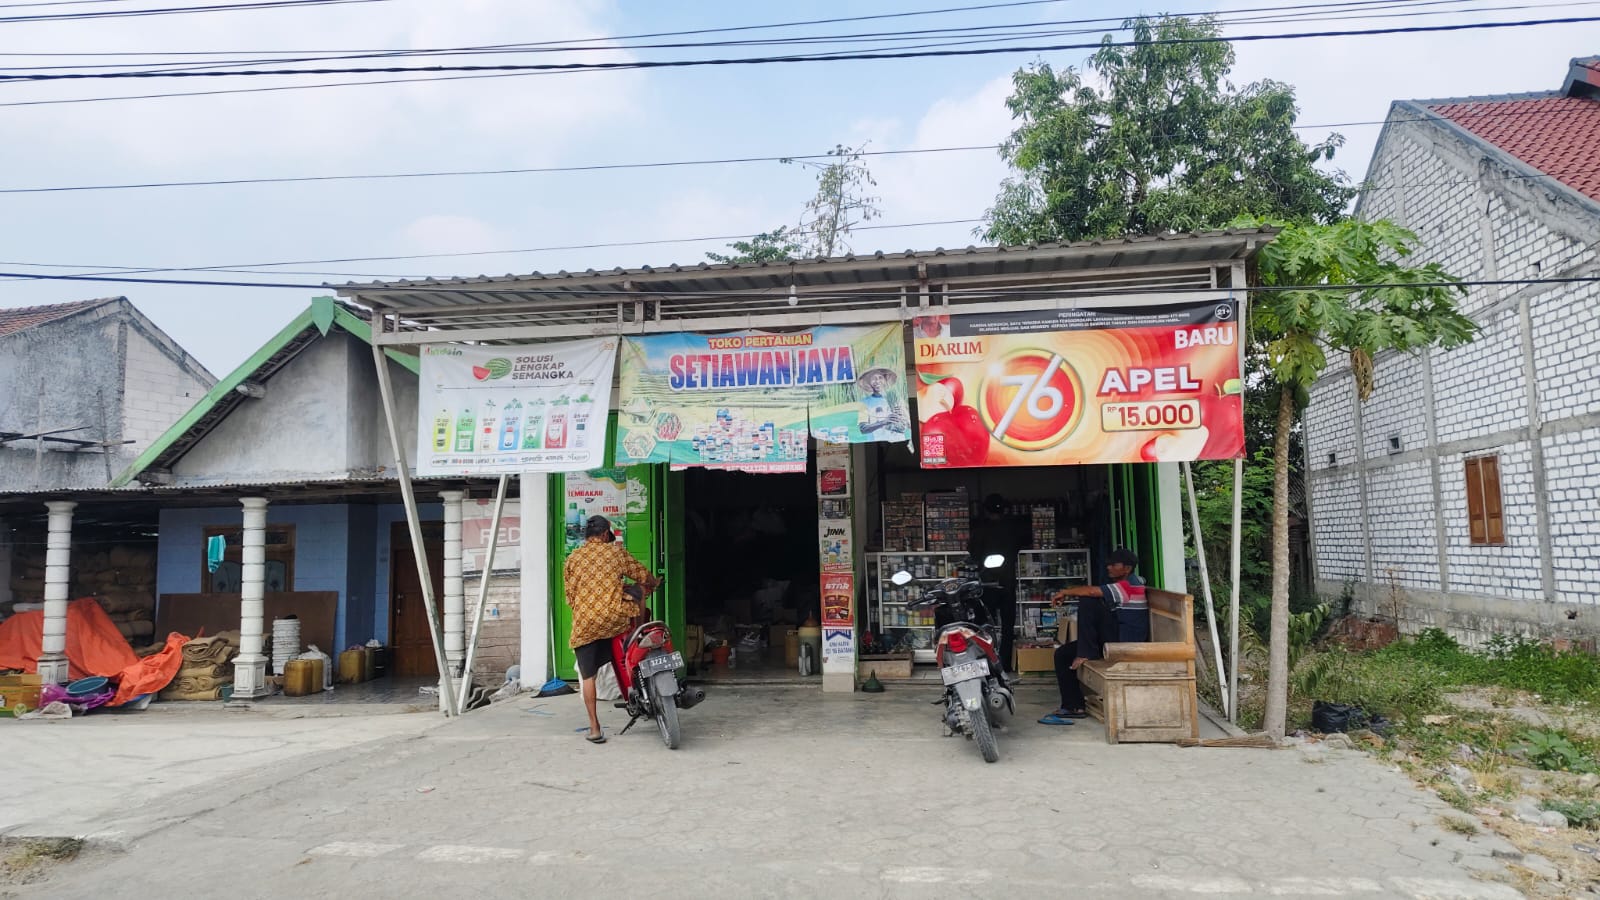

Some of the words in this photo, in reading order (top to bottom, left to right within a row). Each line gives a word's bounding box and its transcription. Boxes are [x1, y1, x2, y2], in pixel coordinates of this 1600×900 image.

[1217, 307, 1230, 317] 21+
[708, 336, 743, 349] TOKO
[745, 333, 812, 347] PERTANIAN
[1174, 325, 1233, 350] BARU
[919, 341, 982, 358] DJARUM
[513, 362, 565, 372] LENGKAP
[515, 355, 554, 363] SOLUSI
[511, 370, 574, 380] SEMANGKA
[670, 350, 792, 389] SETIAWAN
[796, 346, 854, 384] JAYA
[1101, 366, 1200, 393] APEL
[992, 352, 1064, 441] 76
[1118, 403, 1194, 427] 15.000
[567, 489, 604, 498] TEMBAKAU
